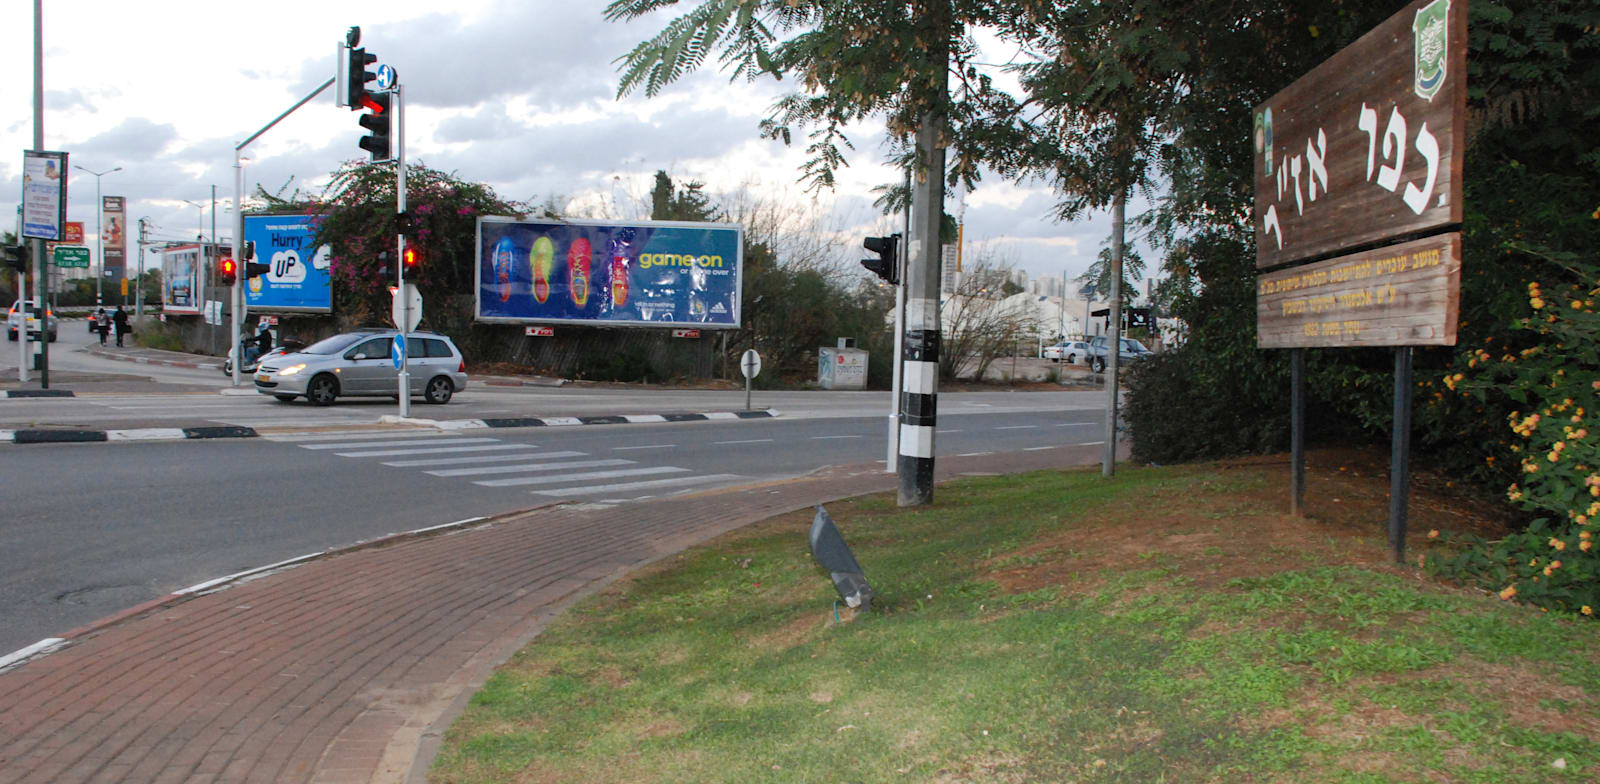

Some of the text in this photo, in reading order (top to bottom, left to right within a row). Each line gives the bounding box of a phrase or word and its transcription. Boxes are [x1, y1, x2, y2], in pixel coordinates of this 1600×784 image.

[1358, 102, 1440, 216] כפר
[271, 232, 303, 251] Hurry
[275, 256, 296, 278] UP
[639, 253, 723, 269] game on
[1412, 248, 1439, 270] מושב
